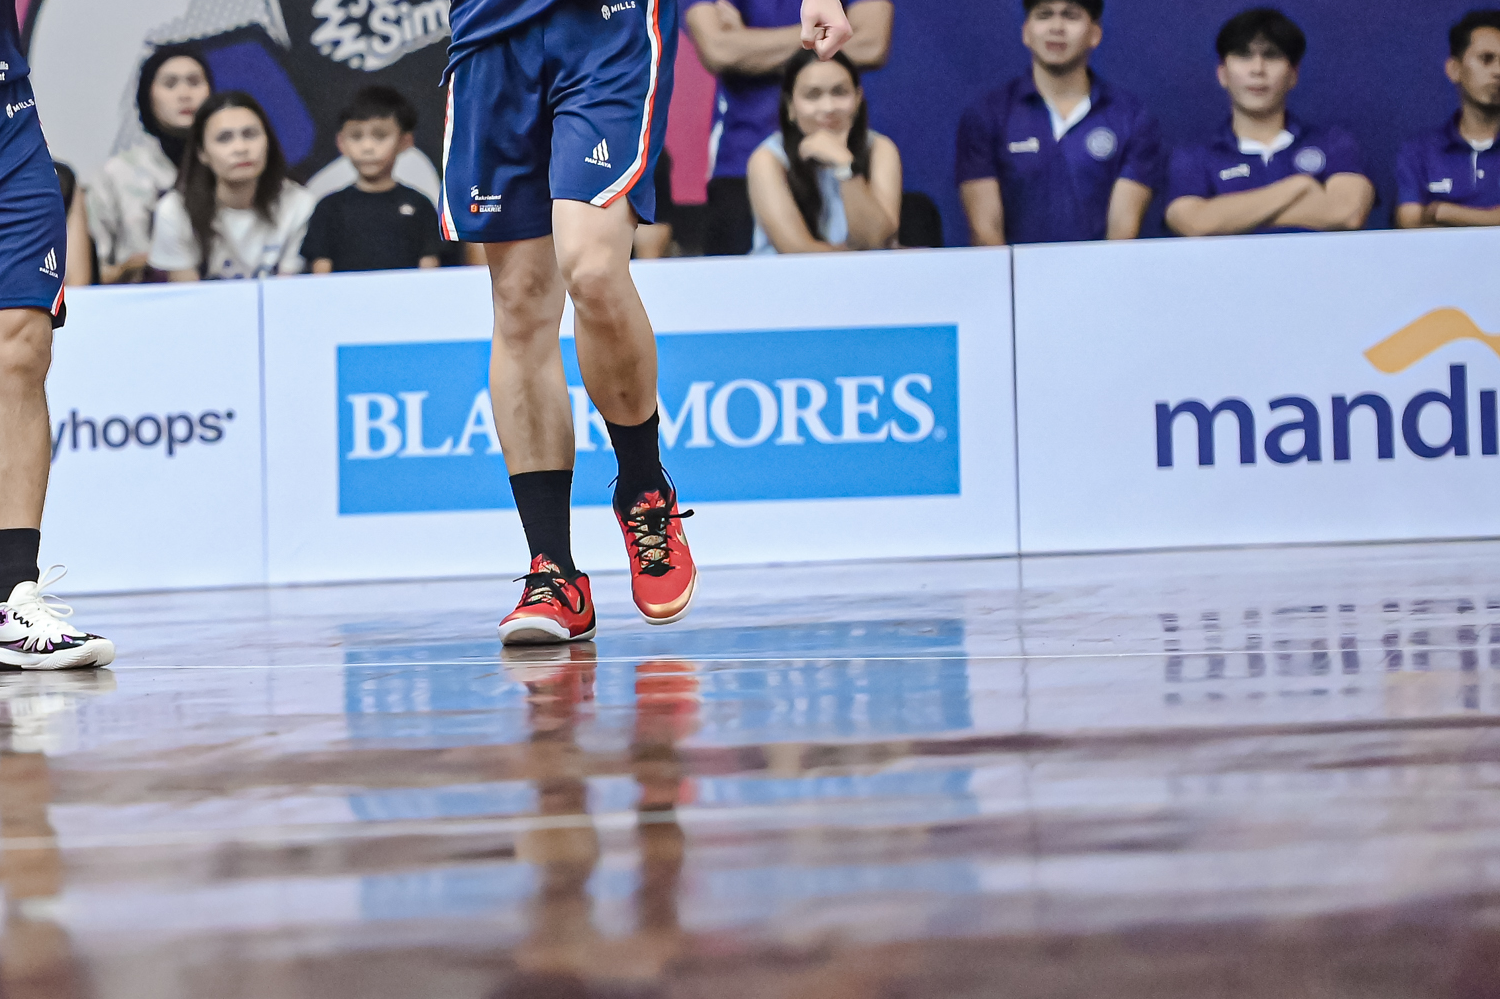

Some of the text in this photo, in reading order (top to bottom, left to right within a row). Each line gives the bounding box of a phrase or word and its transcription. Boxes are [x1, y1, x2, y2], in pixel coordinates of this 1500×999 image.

[611, 1, 636, 13] MILLS
[12, 98, 35, 113] MILLS
[346, 372, 937, 461] BLAKMORES
